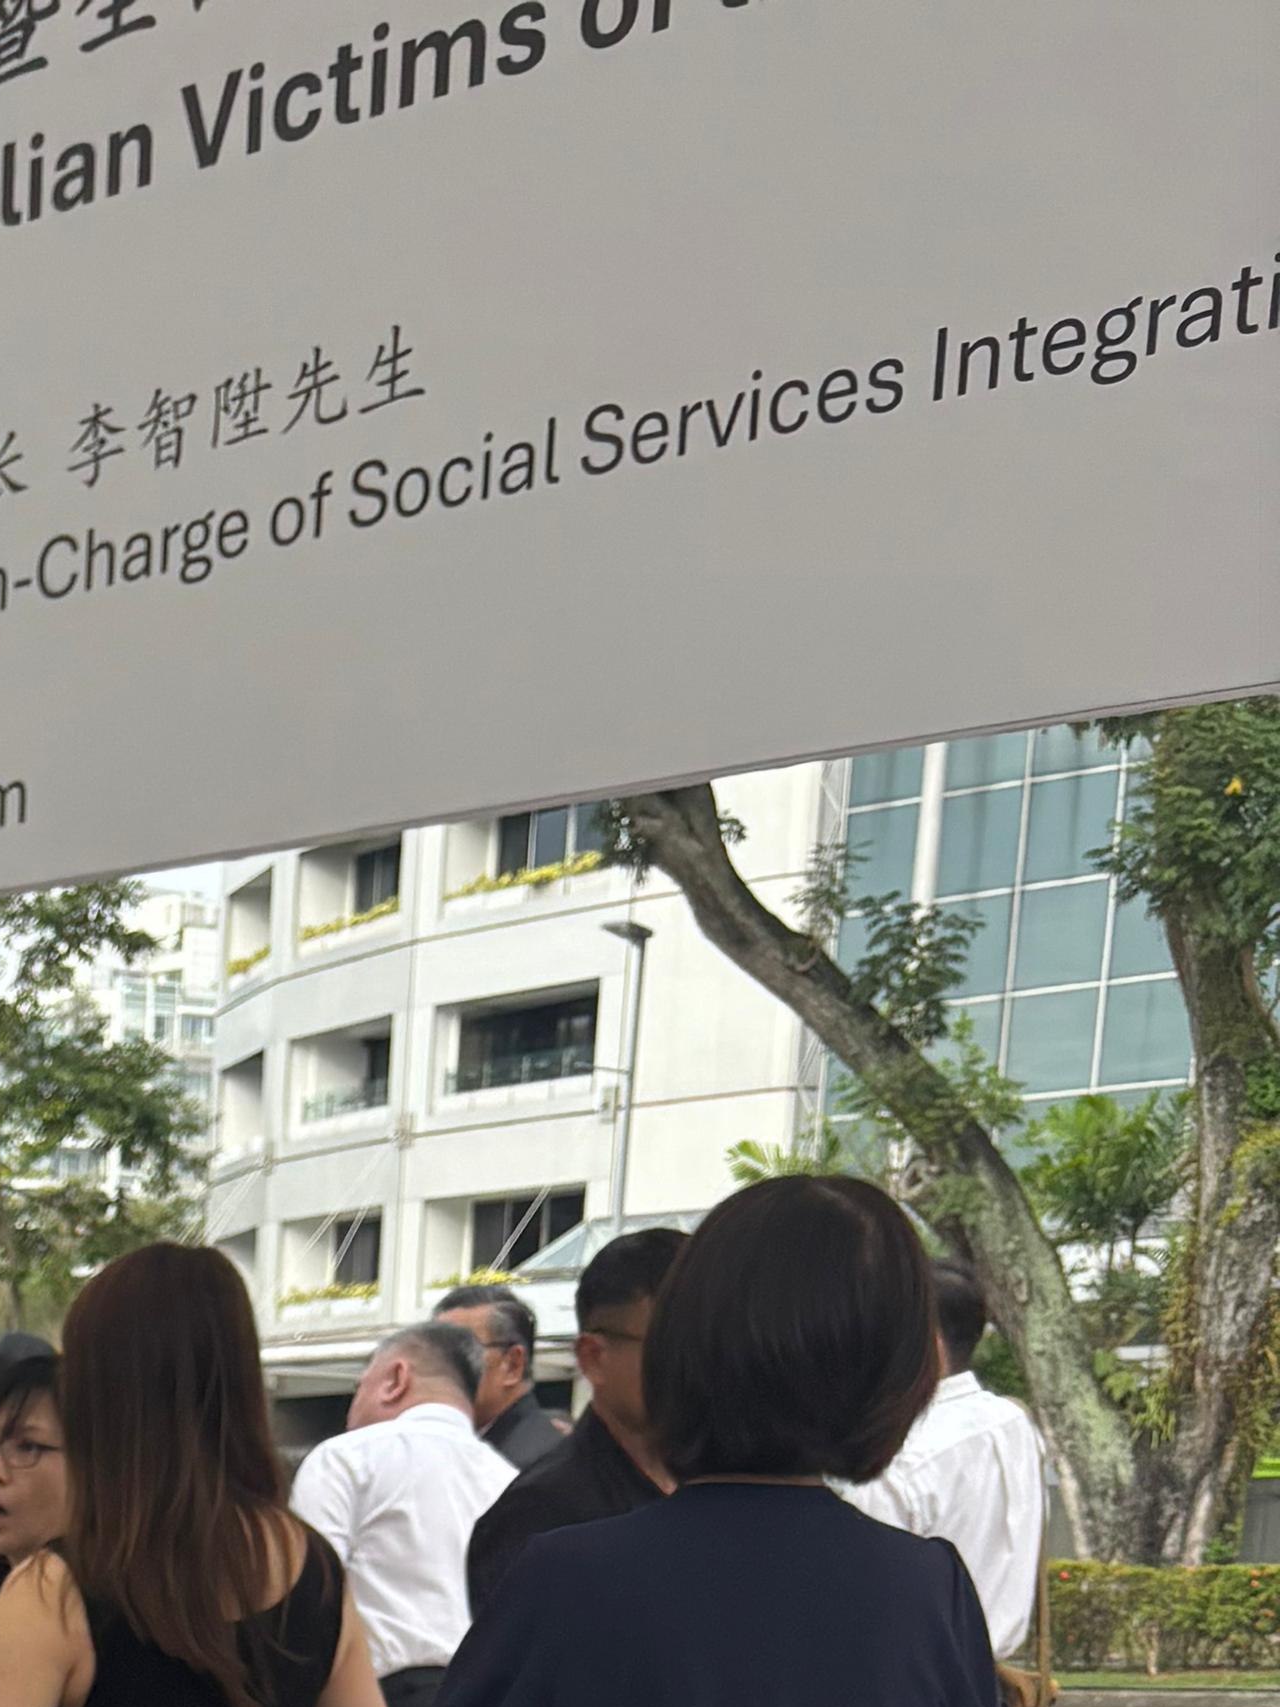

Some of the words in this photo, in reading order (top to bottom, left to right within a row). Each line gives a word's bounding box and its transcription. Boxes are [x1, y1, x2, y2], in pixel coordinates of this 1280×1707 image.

[180, 0, 546, 169] Victims
[270, 470, 333, 546] of
[348, 417, 560, 528] Social
[581, 359, 904, 475] Services
